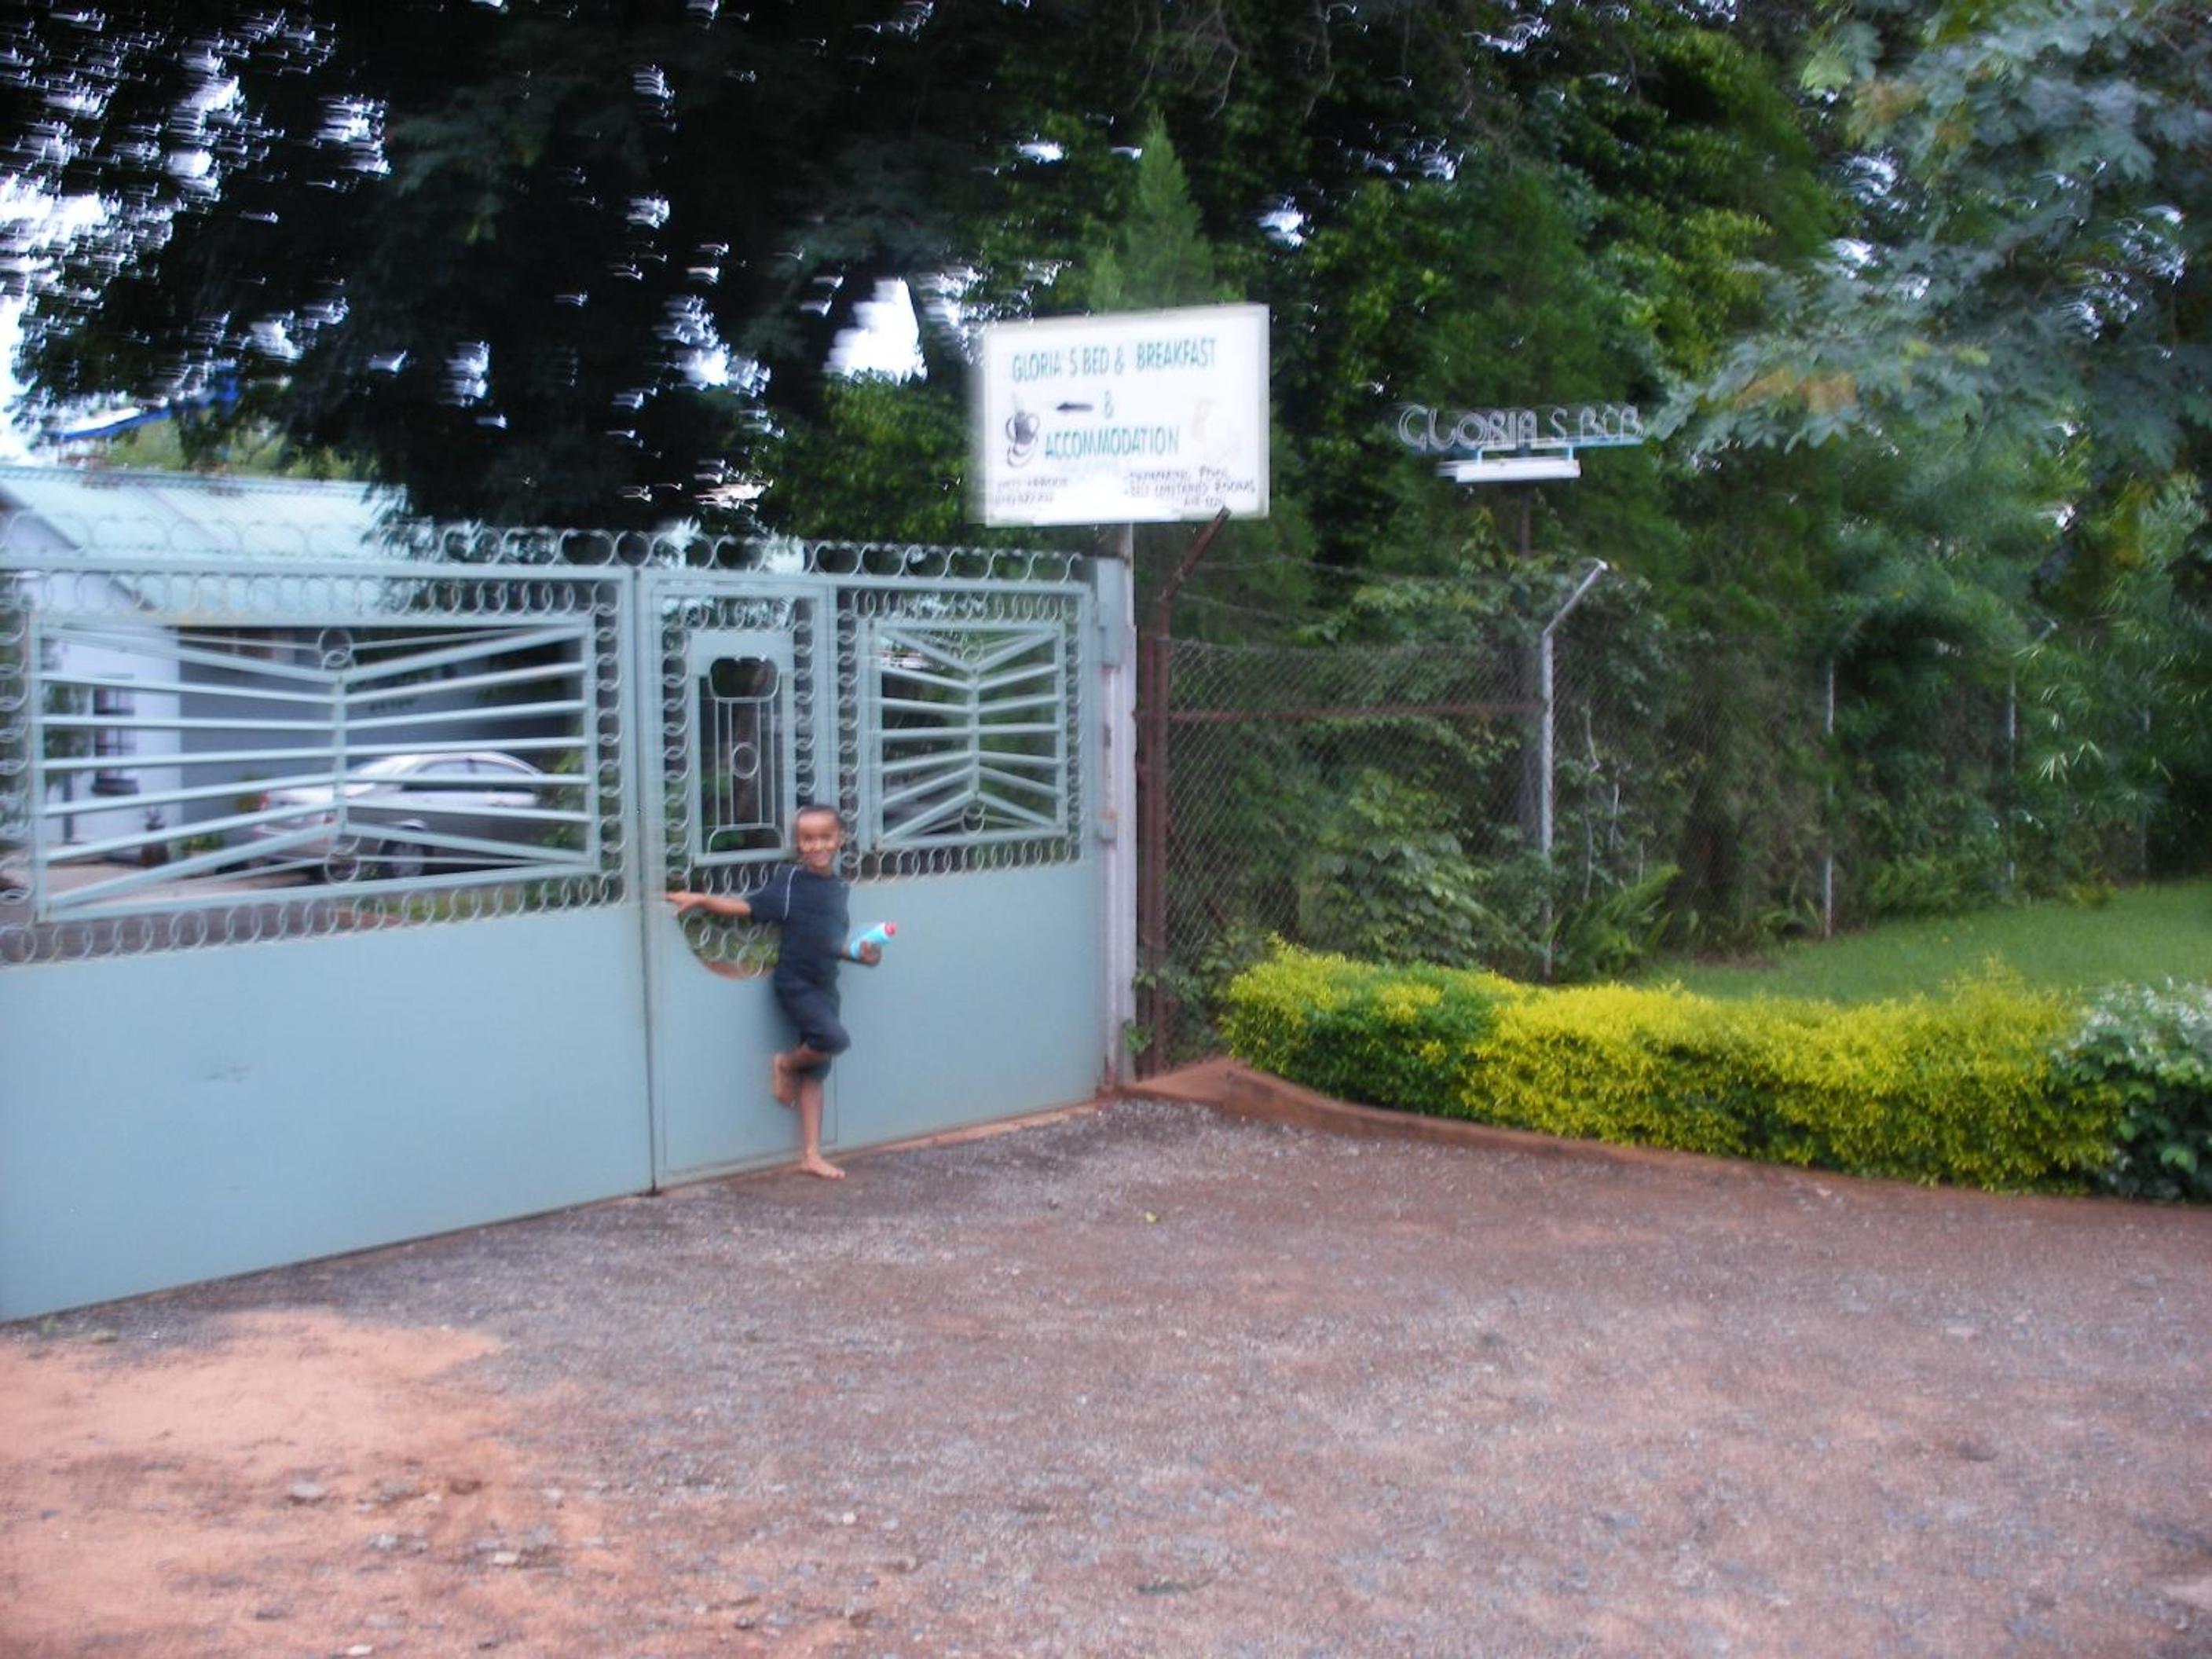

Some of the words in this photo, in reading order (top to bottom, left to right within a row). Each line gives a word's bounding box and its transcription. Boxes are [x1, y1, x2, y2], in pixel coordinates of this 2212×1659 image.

[1012, 350, 1063, 383] GLORIA
[1082, 346, 1110, 376] BED
[1136, 336, 1217, 371] BREAKFAST
[1046, 426, 1178, 460] ACCOMMODATION
